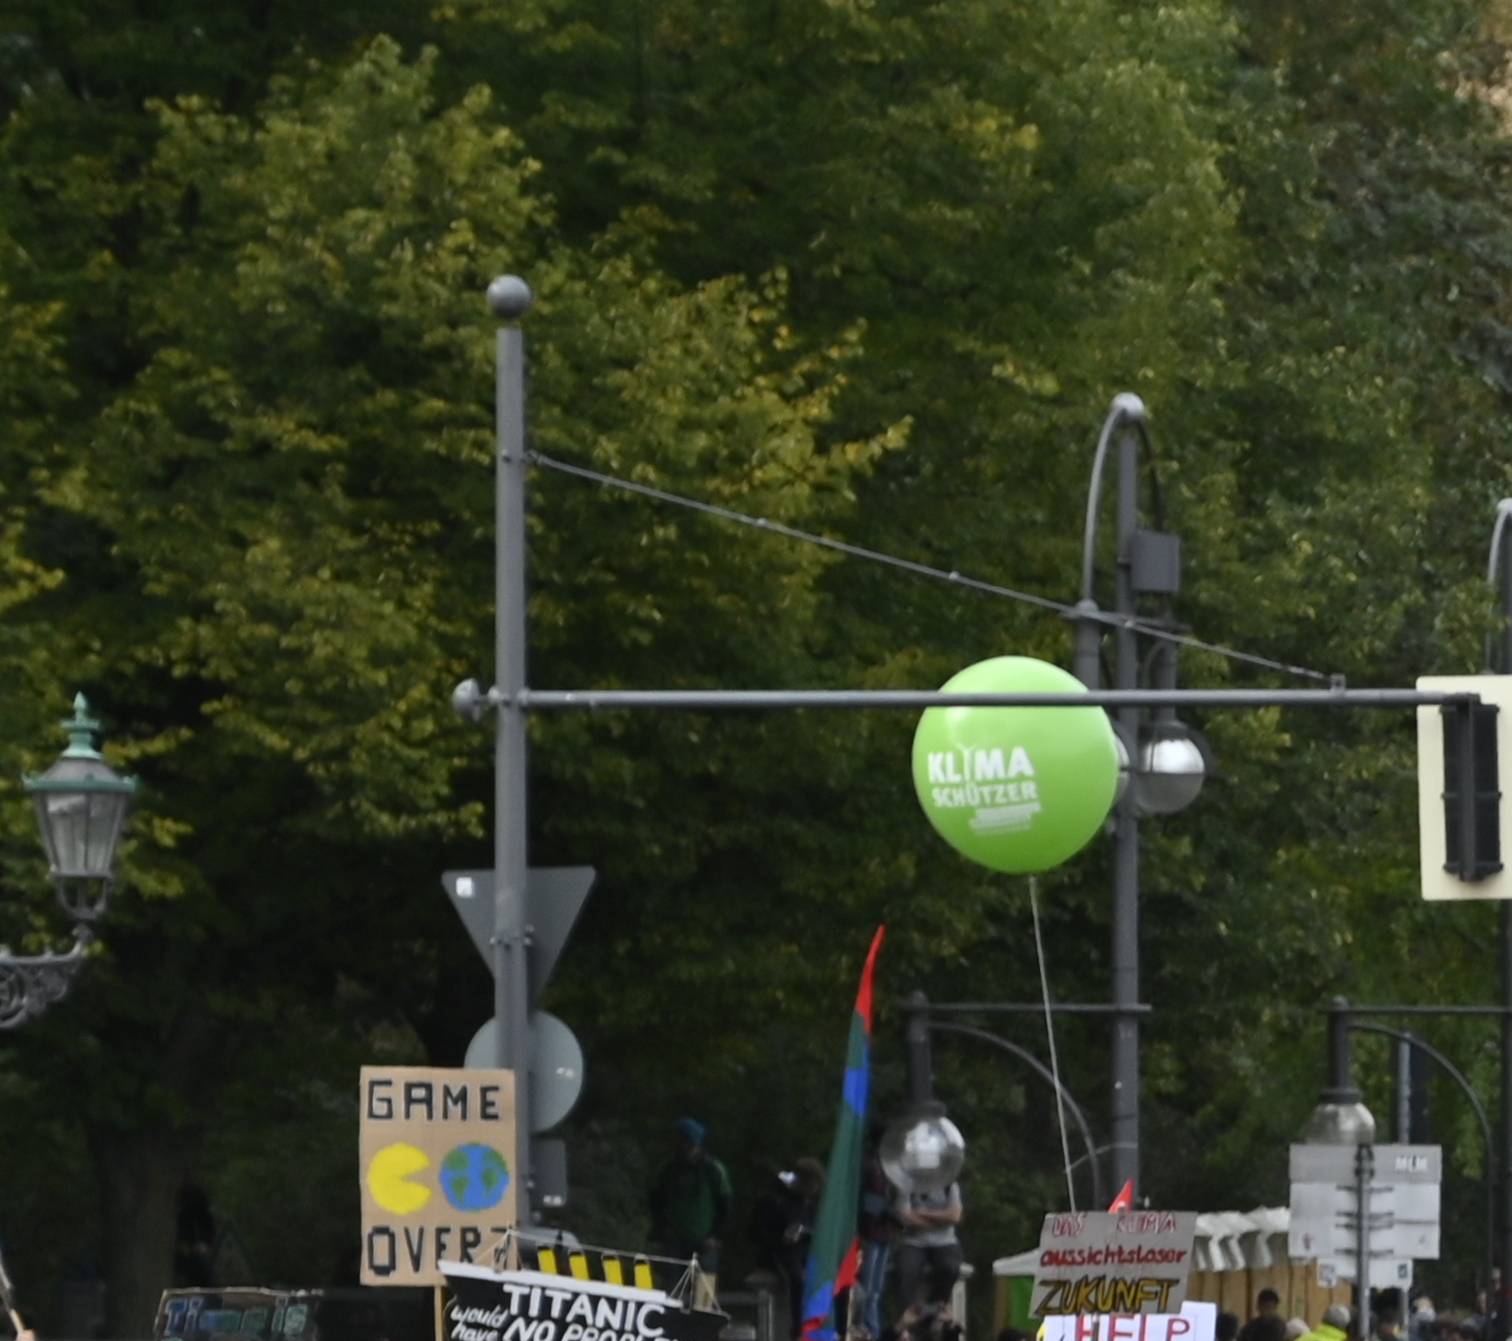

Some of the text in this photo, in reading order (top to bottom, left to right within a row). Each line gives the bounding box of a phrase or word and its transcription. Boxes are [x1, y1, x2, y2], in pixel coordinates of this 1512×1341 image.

[928, 746, 1035, 783] KLIMA
[931, 780, 1039, 808] SCHÜTZER
[367, 1080, 500, 1121] GAME
[451, 1304, 504, 1330] would
[503, 1284, 665, 1337] TITANIC
